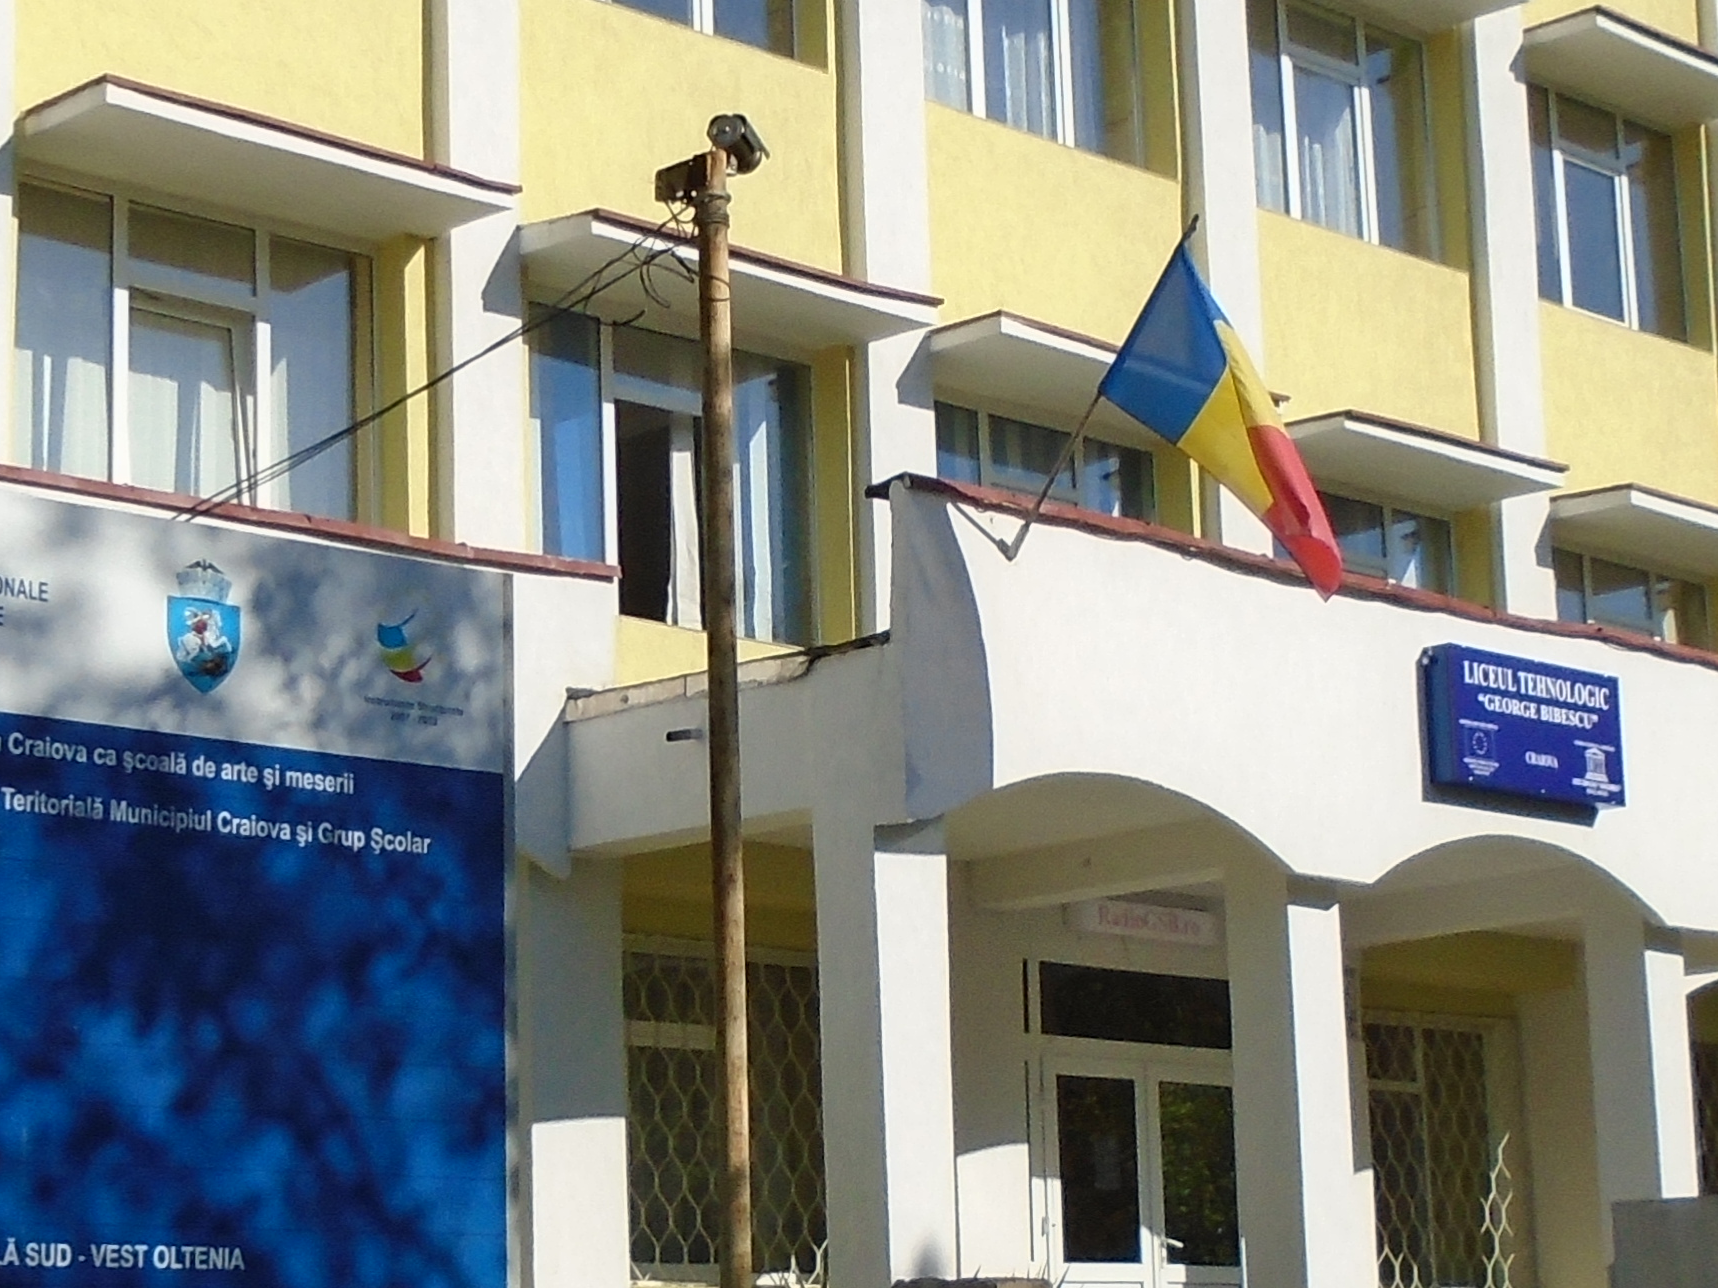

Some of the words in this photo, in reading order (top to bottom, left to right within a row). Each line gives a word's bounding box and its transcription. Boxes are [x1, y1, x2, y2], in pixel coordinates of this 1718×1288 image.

[1463, 660, 1517, 692] LICEUL
[1517, 671, 1609, 711] TEHNOLOGIC
[8, 732, 87, 763] Craiova
[93, 748, 117, 766] ca
[192, 754, 216, 779] de
[221, 760, 259, 784] arte
[285, 769, 355, 796] meserii
[1, 786, 104, 820] Teritorială
[109, 799, 213, 833] Municipiul
[217, 810, 291, 841] Craiova
[317, 822, 366, 850] Grup
[25, 1242, 72, 1268] SUD
[90, 1244, 148, 1269] VEST
[153, 1244, 245, 1271] OLTENIA
